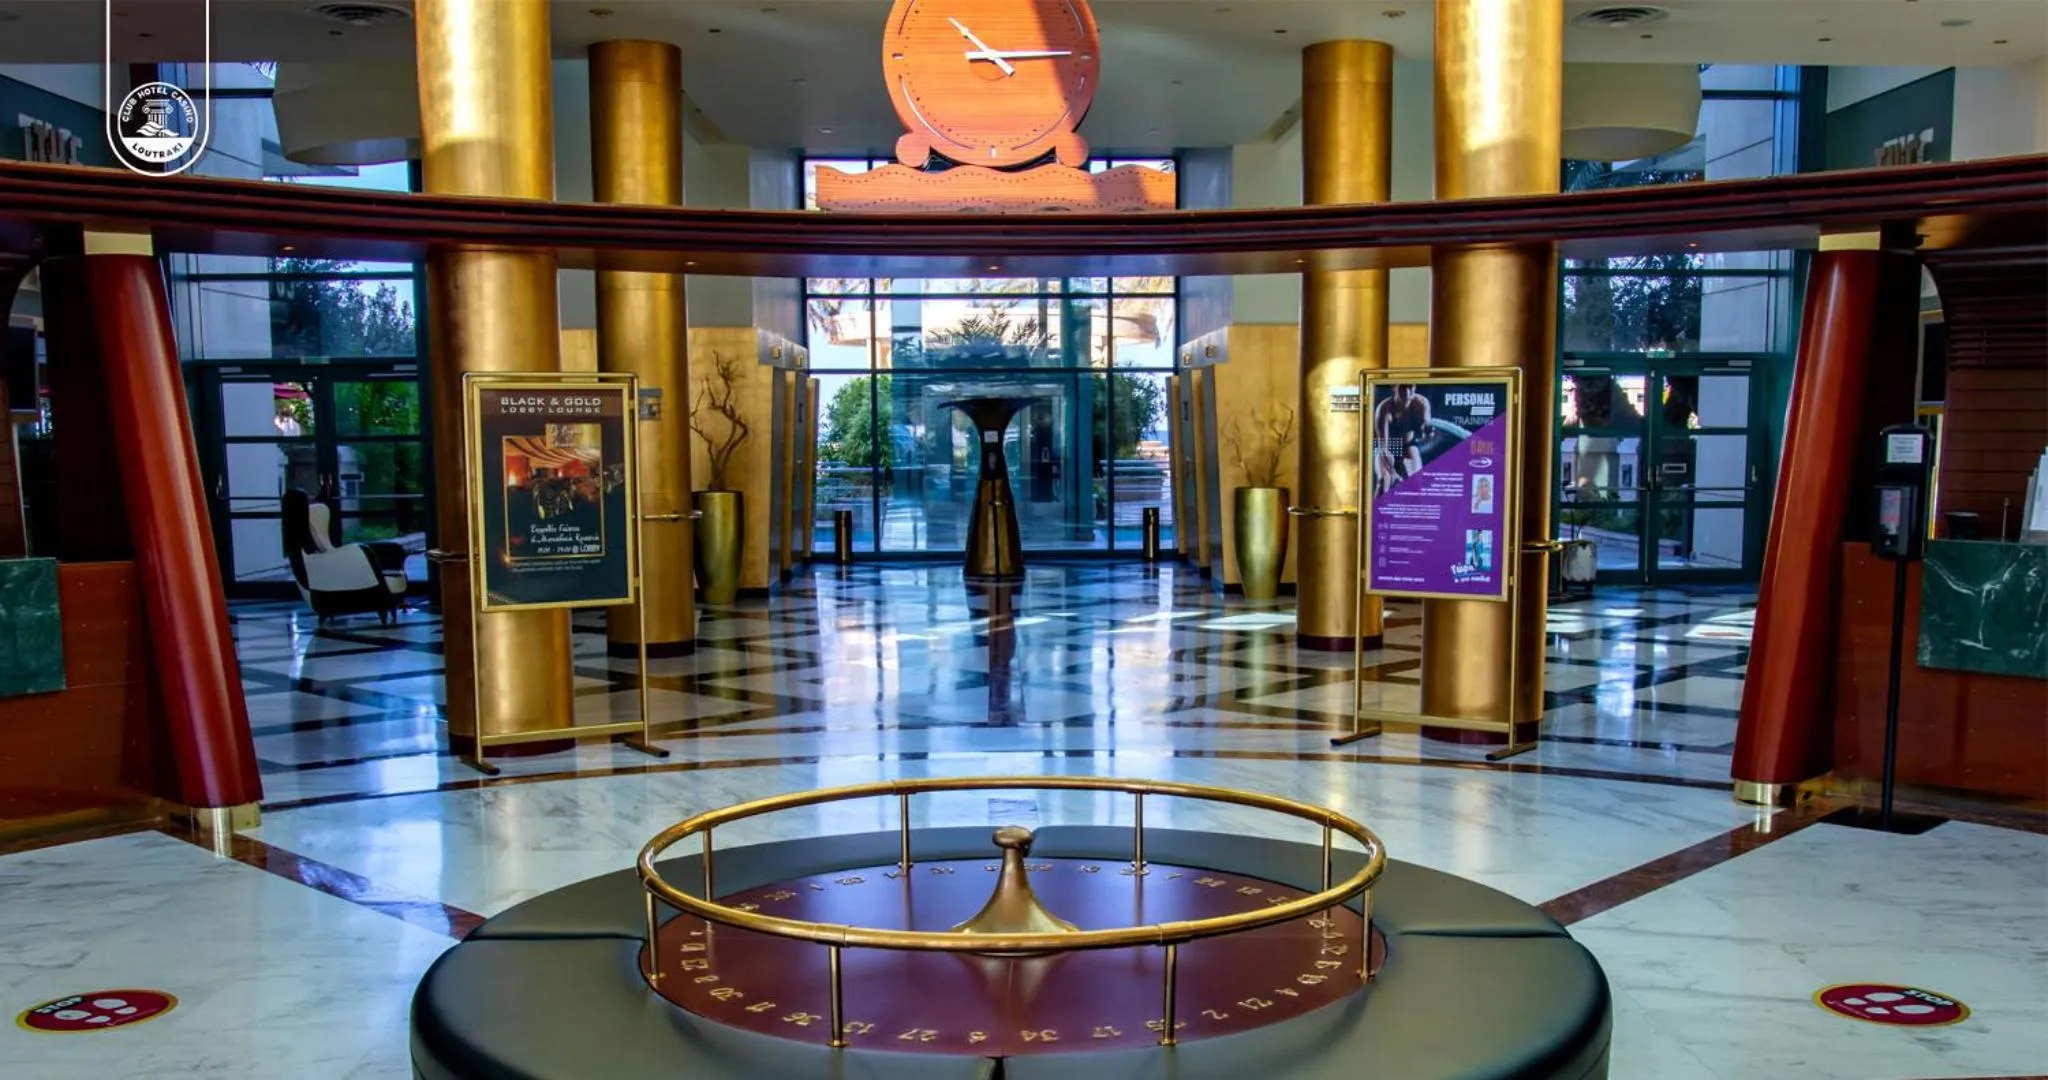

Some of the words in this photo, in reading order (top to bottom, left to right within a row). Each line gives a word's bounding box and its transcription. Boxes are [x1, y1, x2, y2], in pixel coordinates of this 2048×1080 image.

[501, 397, 546, 406] BLACK
[550, 398, 559, 406] &
[564, 397, 602, 406] GOLD
[1445, 393, 1496, 406] PERSONAL
[1452, 415, 1495, 425] TRAINING
[35, 995, 83, 1014] STOP
[1904, 989, 1954, 1006] STOP
[897, 1027, 939, 1042] 27
[1020, 1028, 1061, 1042] 34
